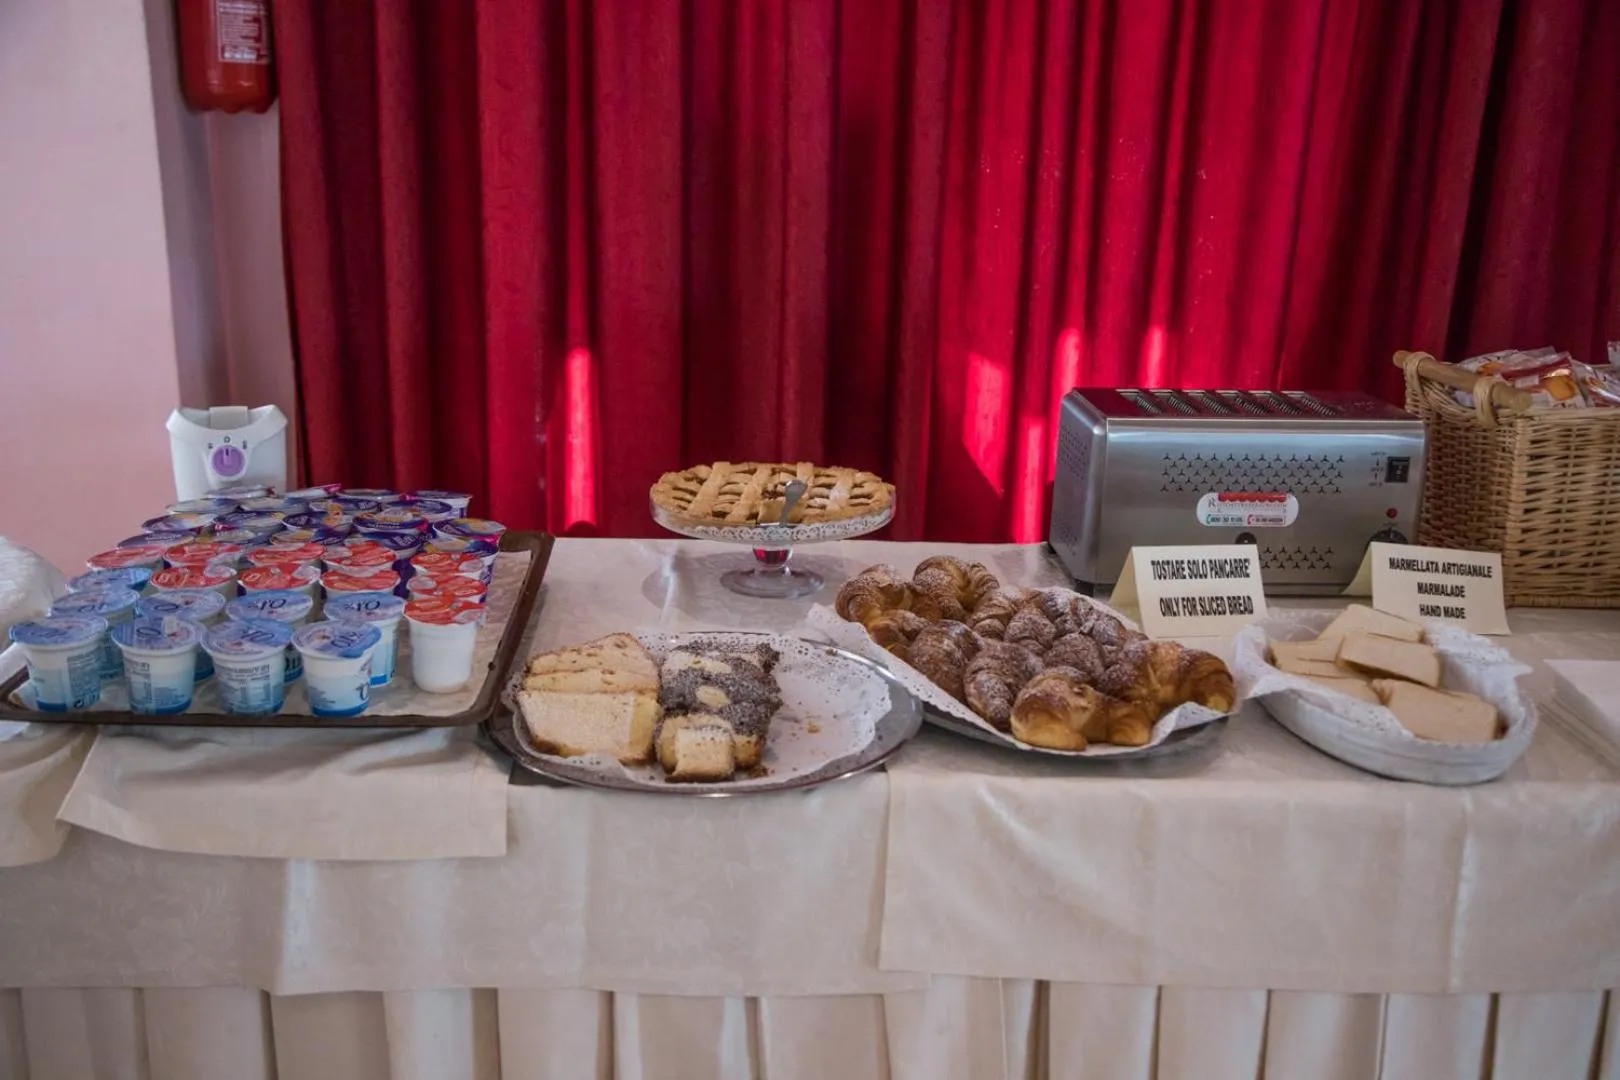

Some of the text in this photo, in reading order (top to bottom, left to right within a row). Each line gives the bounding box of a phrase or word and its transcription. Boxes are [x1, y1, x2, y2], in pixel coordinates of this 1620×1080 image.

[1150, 559, 1187, 580] TOSTARE
[1187, 559, 1208, 579] SOLO
[1389, 557, 1493, 578] MARMELLATA ARTIGIANALE
[1417, 582, 1466, 598] MARMALADE
[1160, 596, 1254, 617] ONLY FOR SLICED BREAD
[1419, 604, 1466, 619] HAND MADE
